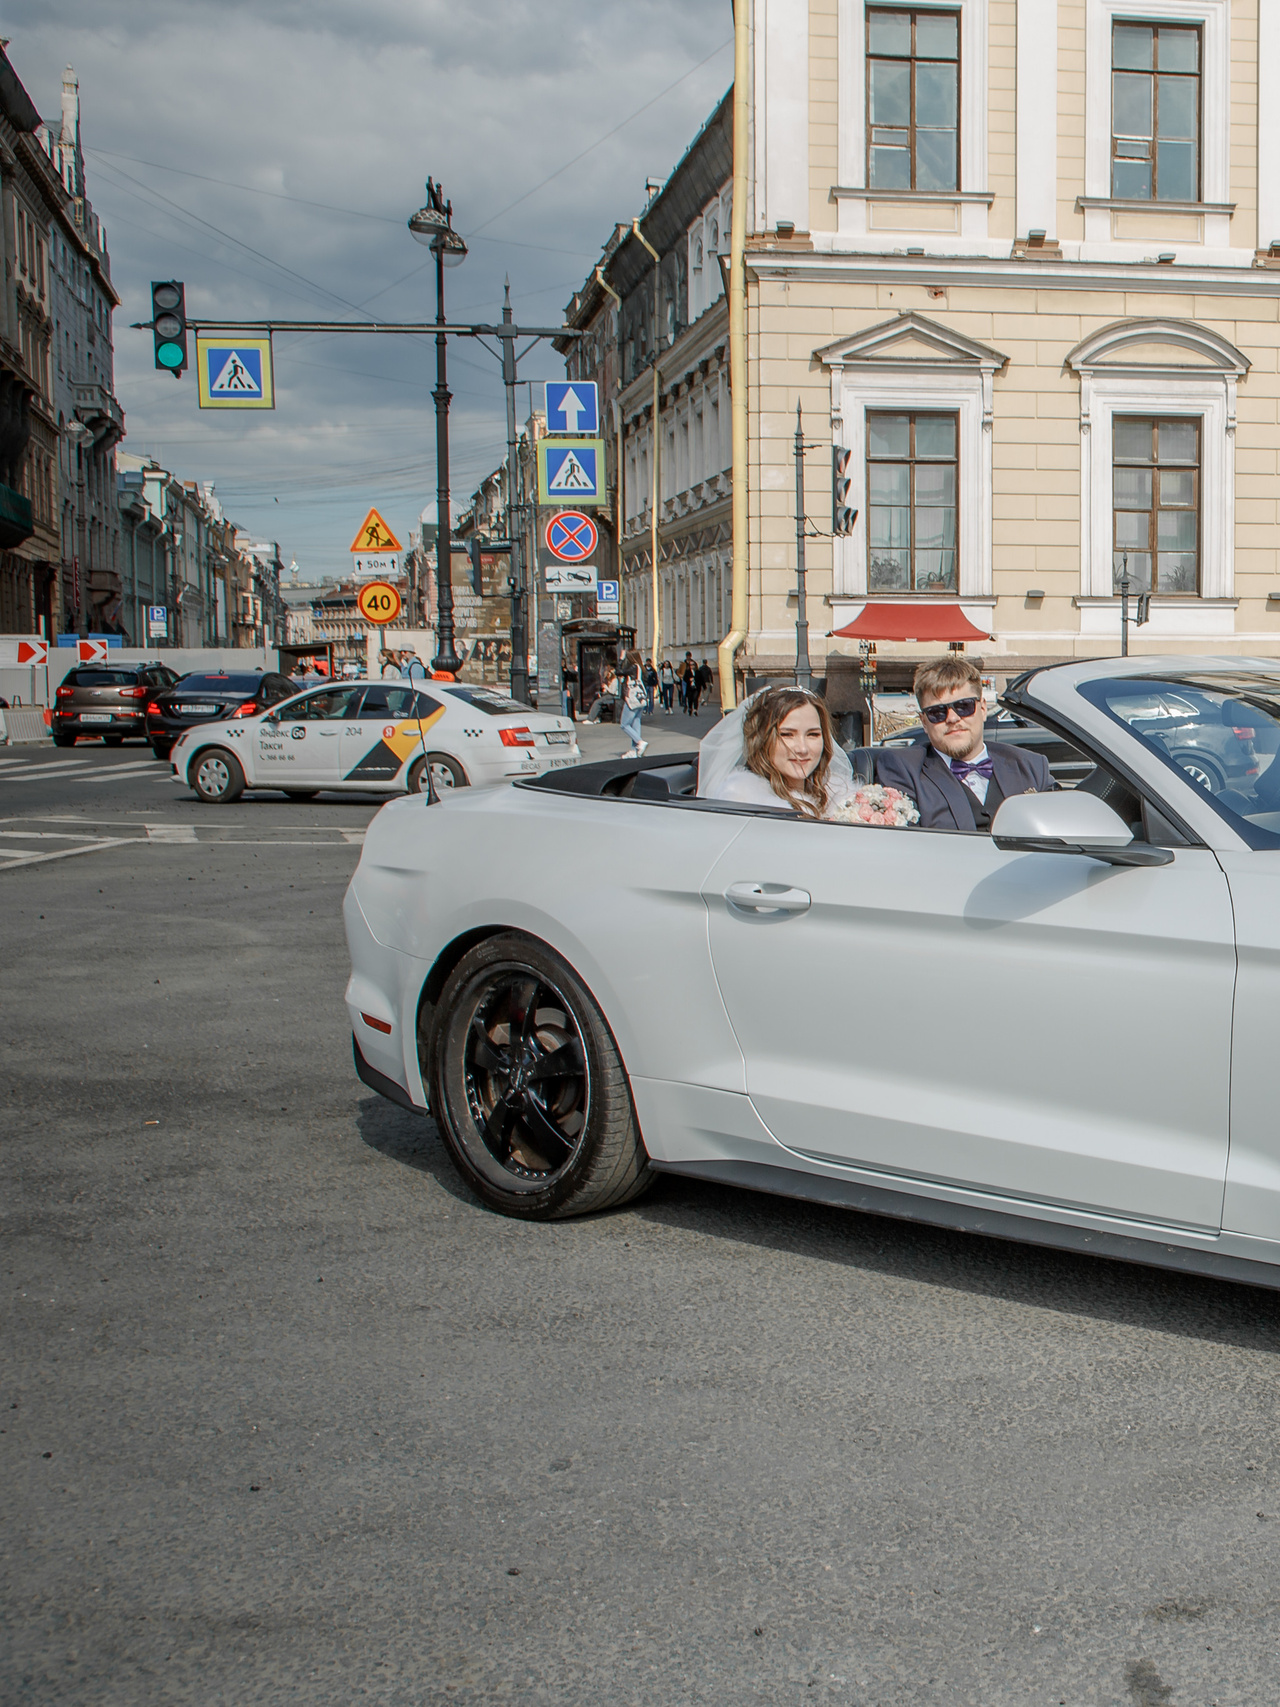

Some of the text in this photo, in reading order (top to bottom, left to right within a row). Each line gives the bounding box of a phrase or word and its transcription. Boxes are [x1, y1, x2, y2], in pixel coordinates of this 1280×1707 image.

[367, 560, 387, 569] 50м
[367, 595, 391, 611] 40
[259, 728, 290, 739] Яндекс
[345, 727, 362, 736] 204
[259, 741, 283, 751] Такси
